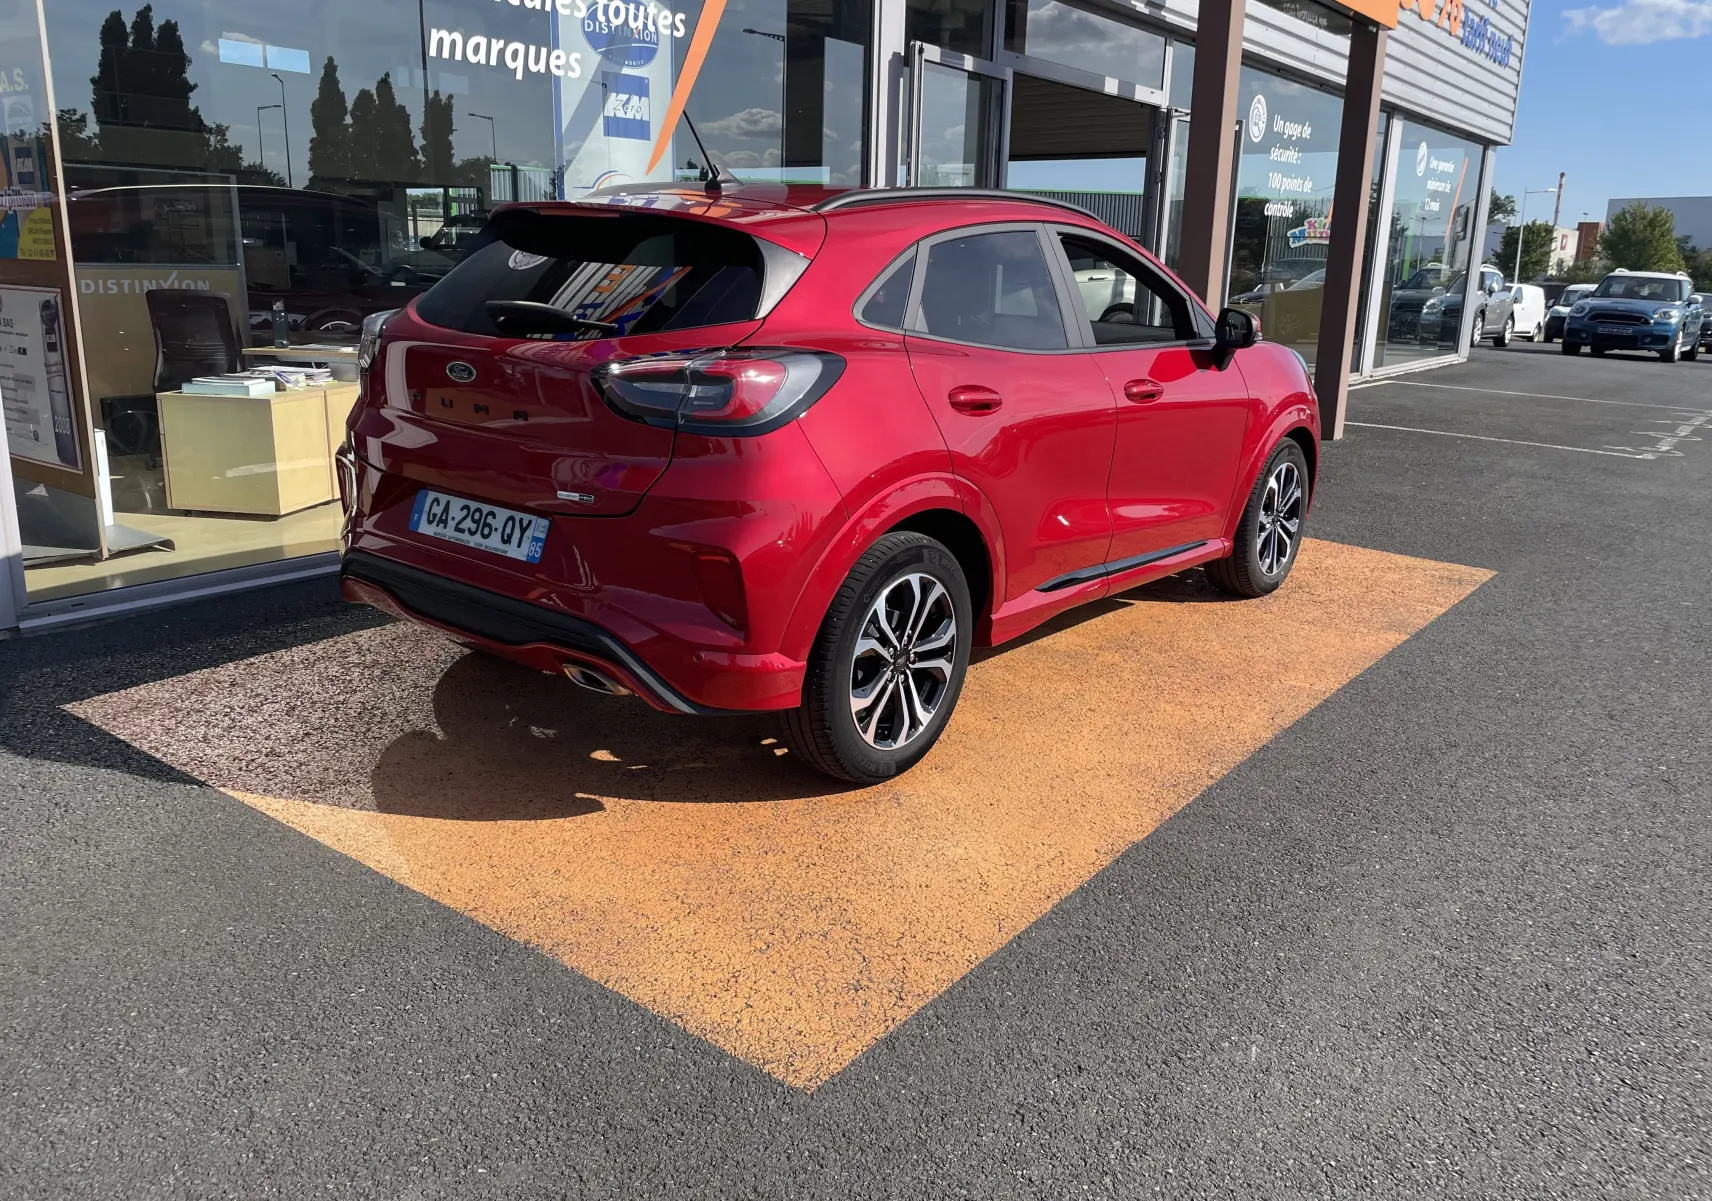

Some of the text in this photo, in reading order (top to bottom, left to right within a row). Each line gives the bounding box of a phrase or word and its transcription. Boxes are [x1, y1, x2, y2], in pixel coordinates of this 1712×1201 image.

[597, 0, 686, 37] toutes
[1462, 6, 1489, 54] tarif
[1488, 31, 1514, 69] neuf
[428, 27, 582, 80] marques
[604, 92, 650, 121] KM
[1273, 114, 1312, 140] Un gage de
[1268, 171, 1312, 194] 100 points de
[1264, 201, 1294, 218] contrôle
[452, 364, 469, 378] Ford
[427, 497, 533, 549] GA-296-QY
[528, 541, 543, 558] 85
